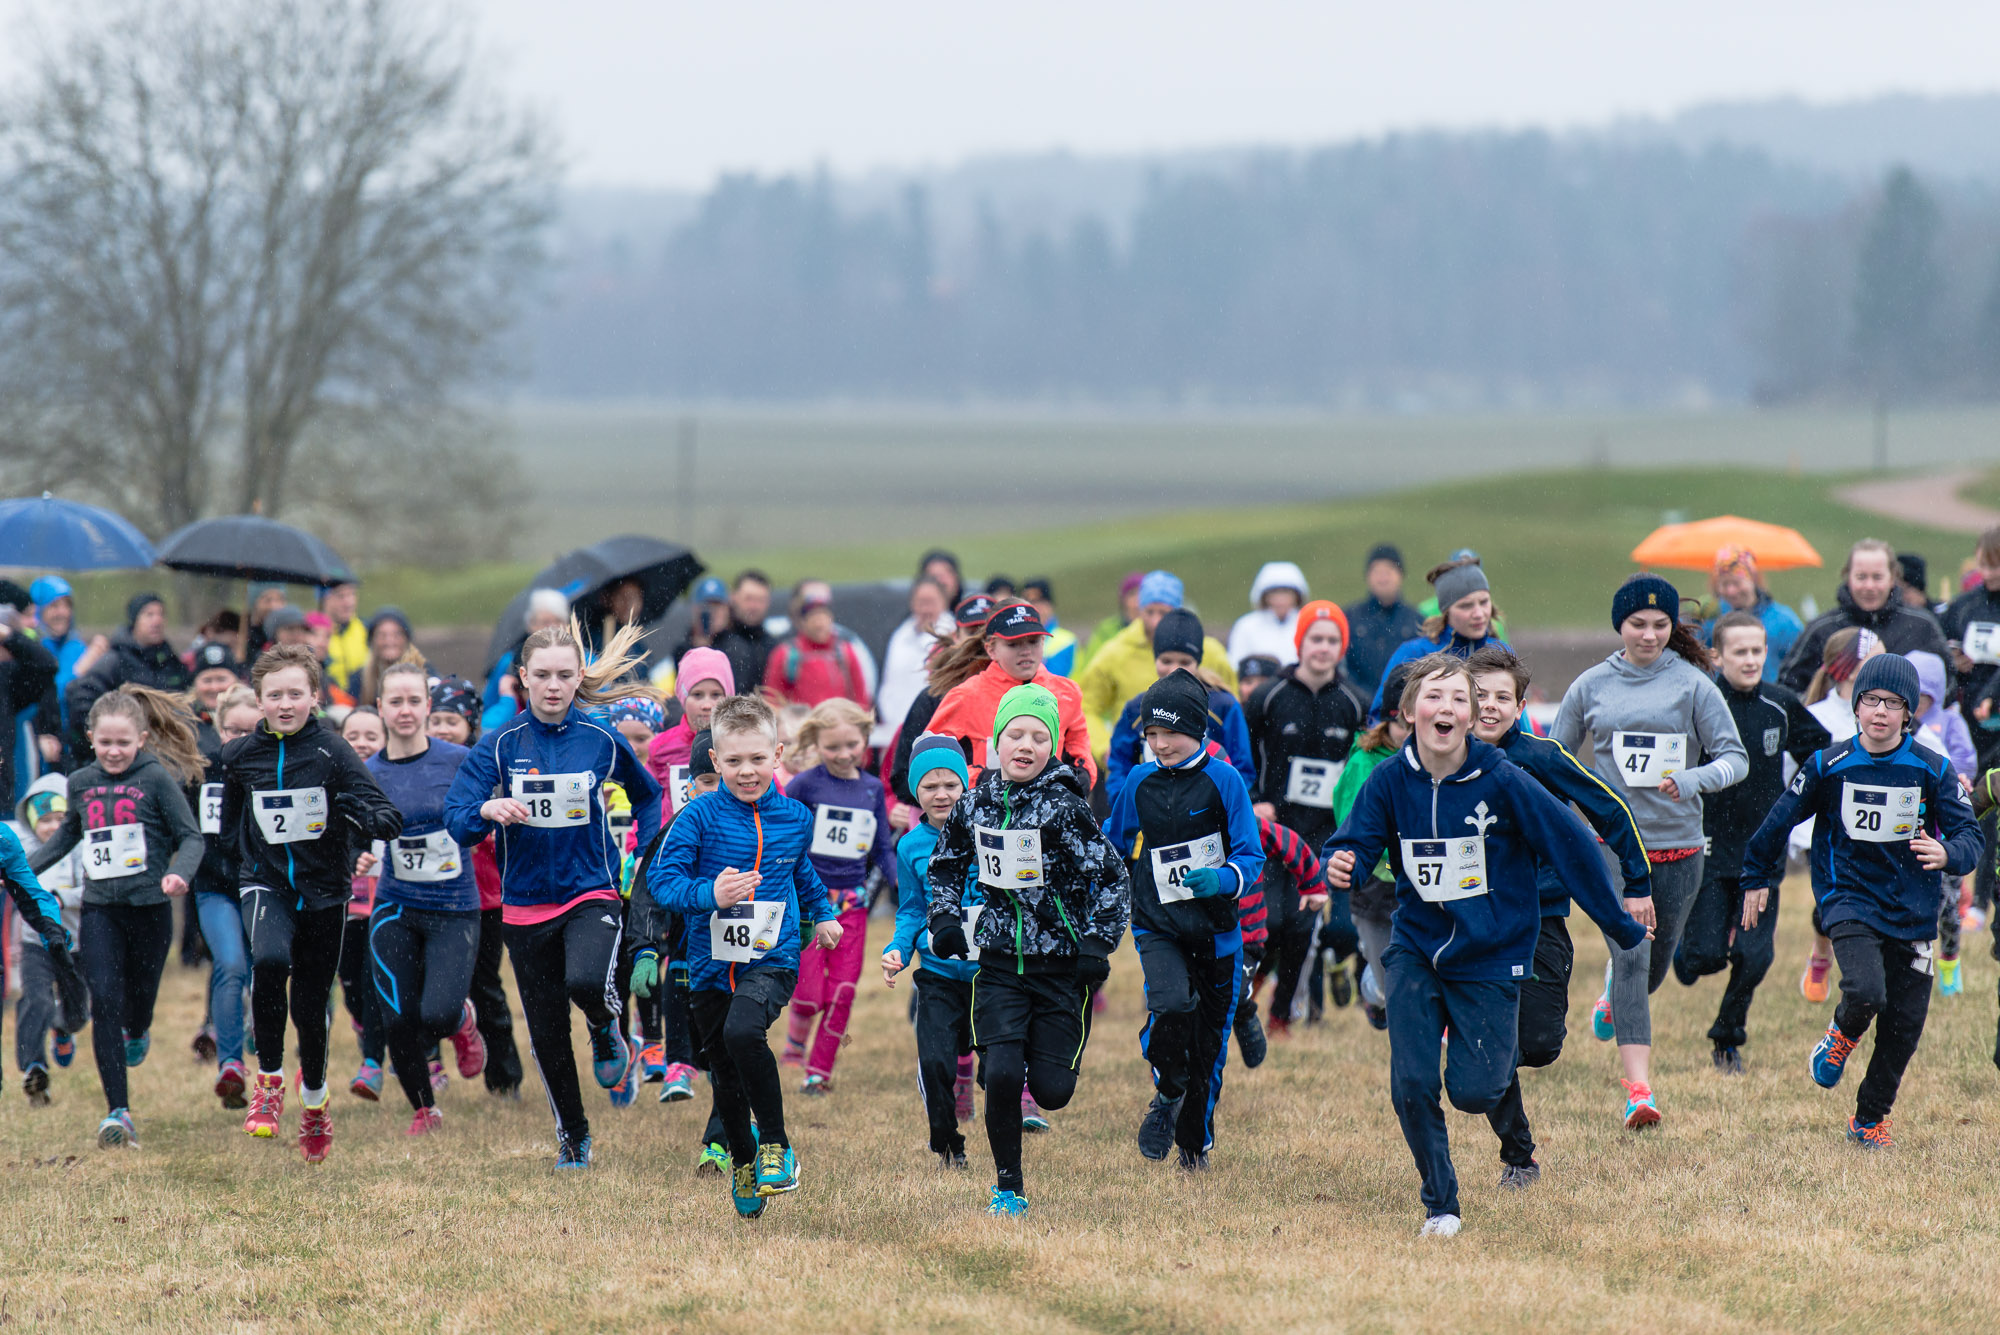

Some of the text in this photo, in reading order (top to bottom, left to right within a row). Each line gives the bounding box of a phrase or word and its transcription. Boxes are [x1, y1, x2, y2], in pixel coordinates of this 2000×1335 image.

[1152, 708, 1181, 724] Woody
[1624, 753, 1651, 773] 47
[680, 785, 690, 804] 3
[1300, 778, 1321, 796] 22
[87, 798, 137, 829] 86
[527, 798, 552, 818] 18
[273, 814, 287, 833] 2
[1854, 809, 1882, 832] 20
[826, 825, 848, 845] 46
[93, 847, 111, 866] 34
[403, 853, 425, 870] 37
[984, 853, 1002, 877] 13
[1417, 863, 1443, 886] 57
[723, 925, 750, 947] 48
